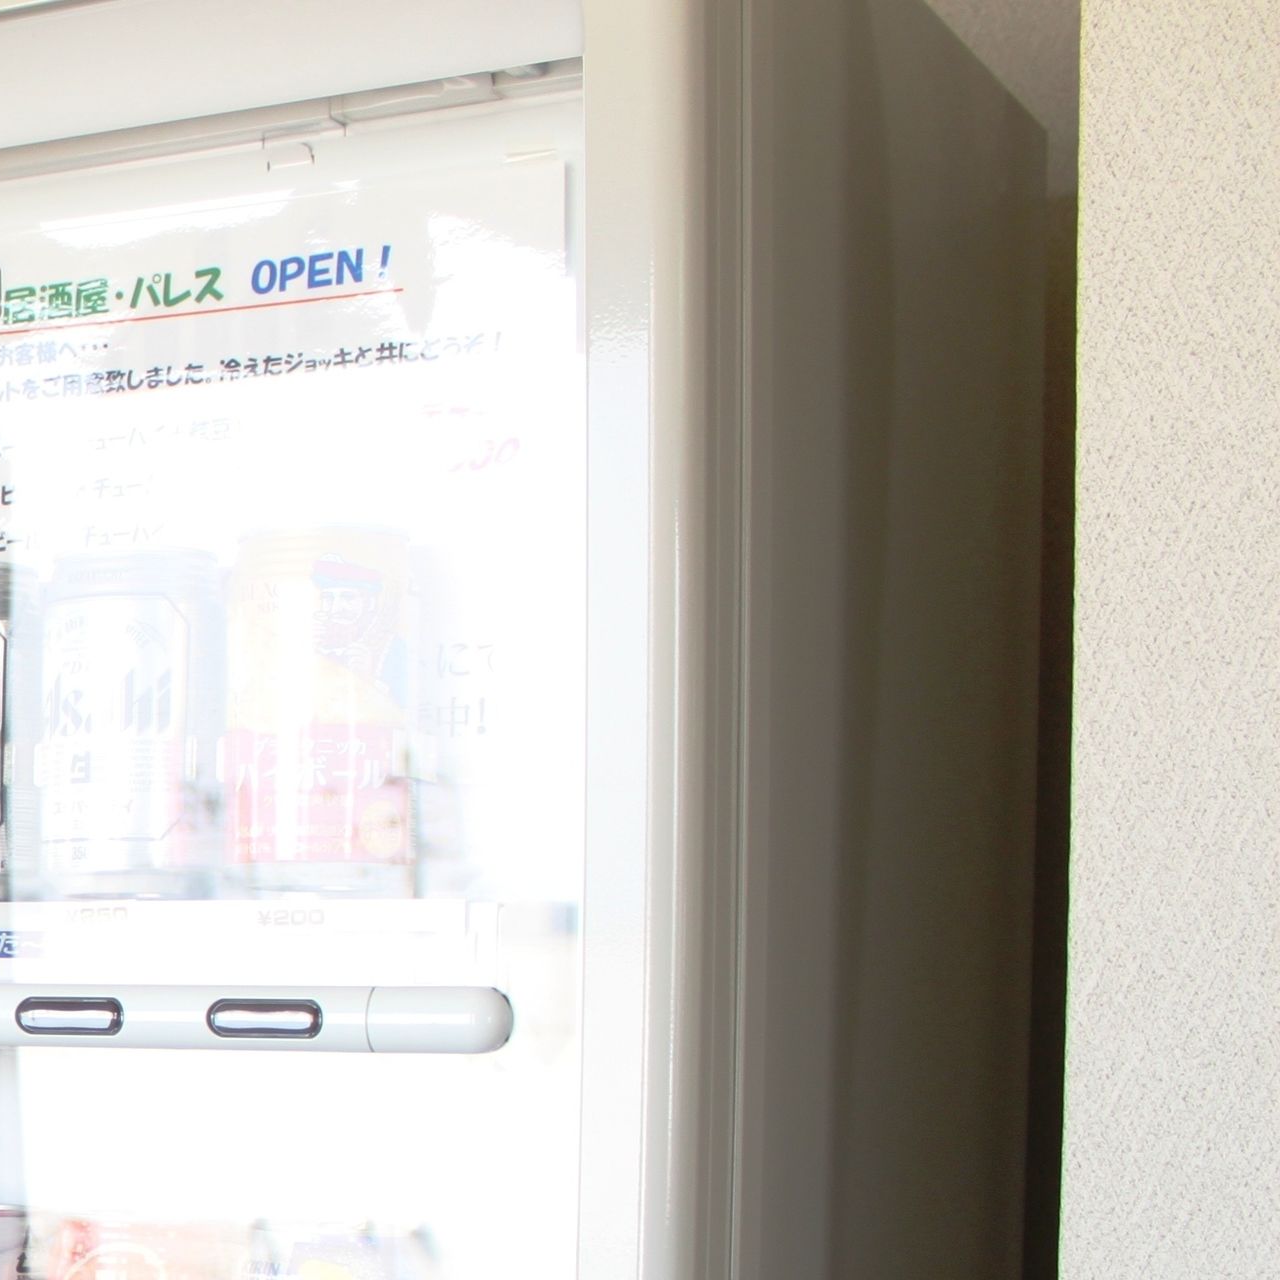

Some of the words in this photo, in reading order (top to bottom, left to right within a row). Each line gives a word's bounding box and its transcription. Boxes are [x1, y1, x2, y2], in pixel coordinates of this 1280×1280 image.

[2, 267, 224, 325] 居酒屋・パレス
